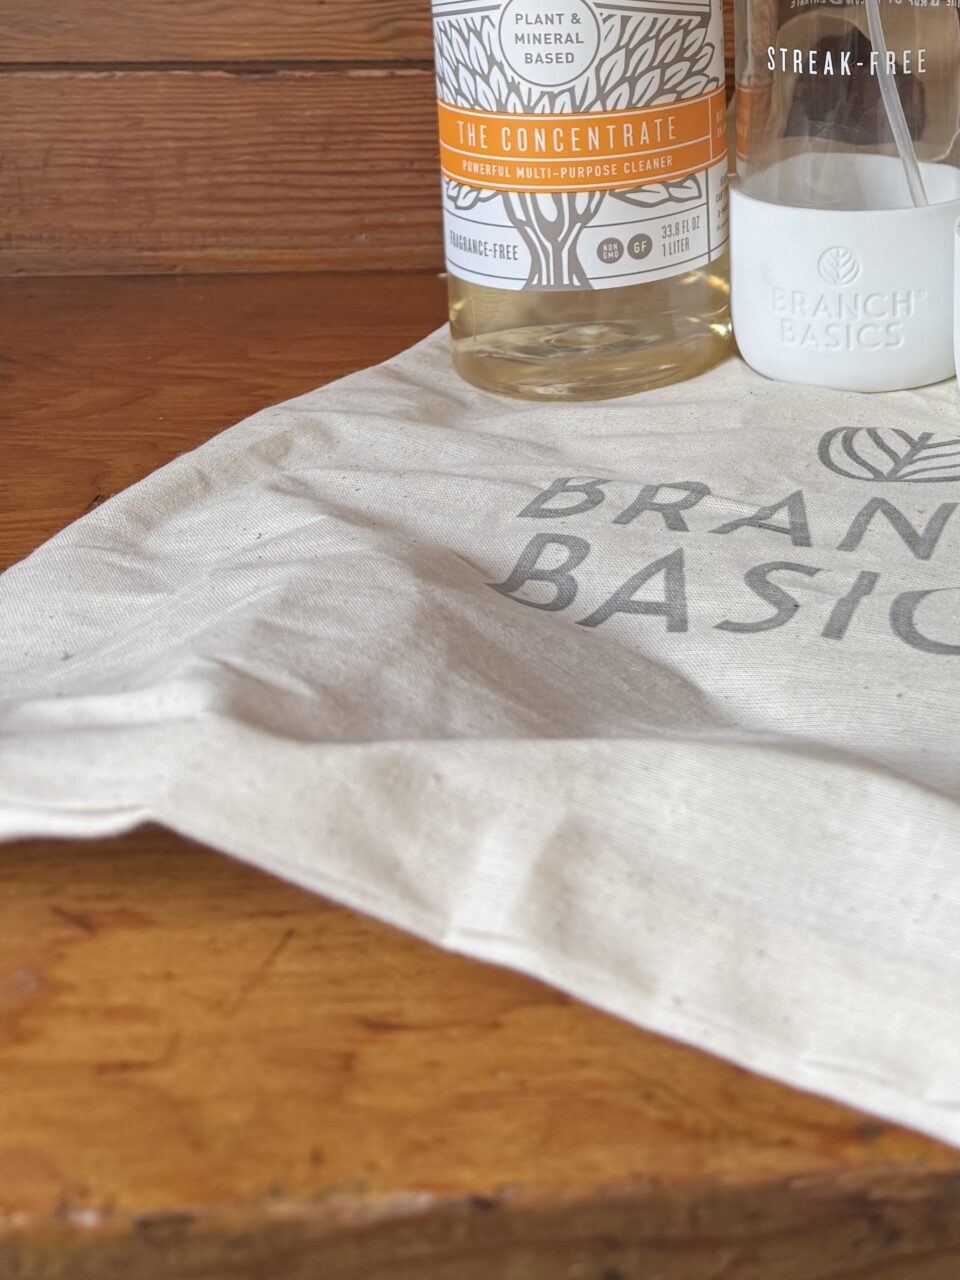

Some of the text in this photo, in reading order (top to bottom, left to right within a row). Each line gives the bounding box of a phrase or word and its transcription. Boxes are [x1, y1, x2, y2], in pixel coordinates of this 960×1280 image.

[515, 12, 582, 25] PLANT &
[514, 31, 585, 45] MINERAL
[524, 52, 575, 65] BASED
[767, 46, 927, 76] STREAK-FREE
[457, 120, 488, 150] THE
[501, 116, 677, 153] CONCENTRATE
[462, 155, 673, 180] POWERFUL MULTI-PURPOSE CLEANER
[662, 215, 700, 239] 33.8 FL OZ
[449, 229, 519, 261] FRAGRANCE-FREE
[602, 243, 618, 252] NON
[633, 240, 648, 253] GF
[669, 237, 690, 256] LITER
[602, 251, 620, 260] GMO
[780, 317, 905, 351] BASICS
